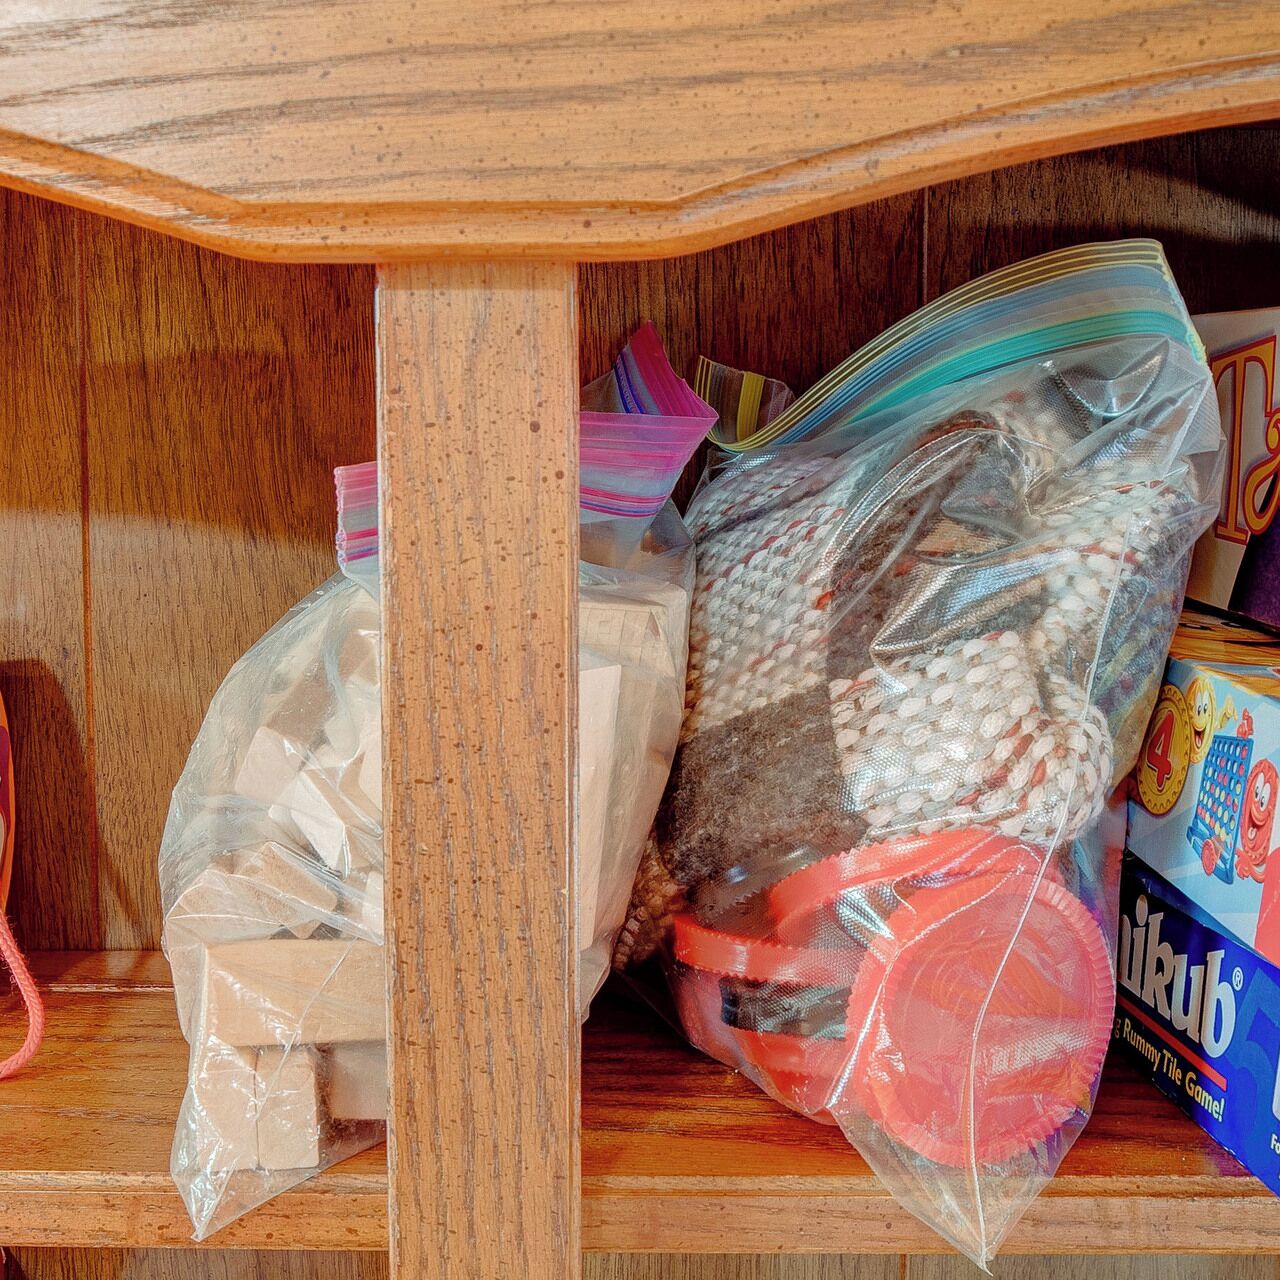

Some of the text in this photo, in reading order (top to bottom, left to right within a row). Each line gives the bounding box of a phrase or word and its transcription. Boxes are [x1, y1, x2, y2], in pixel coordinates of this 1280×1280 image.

[1145, 711, 1174, 792] 4
[1123, 1021, 1225, 1123] Rummy Tile Game!
